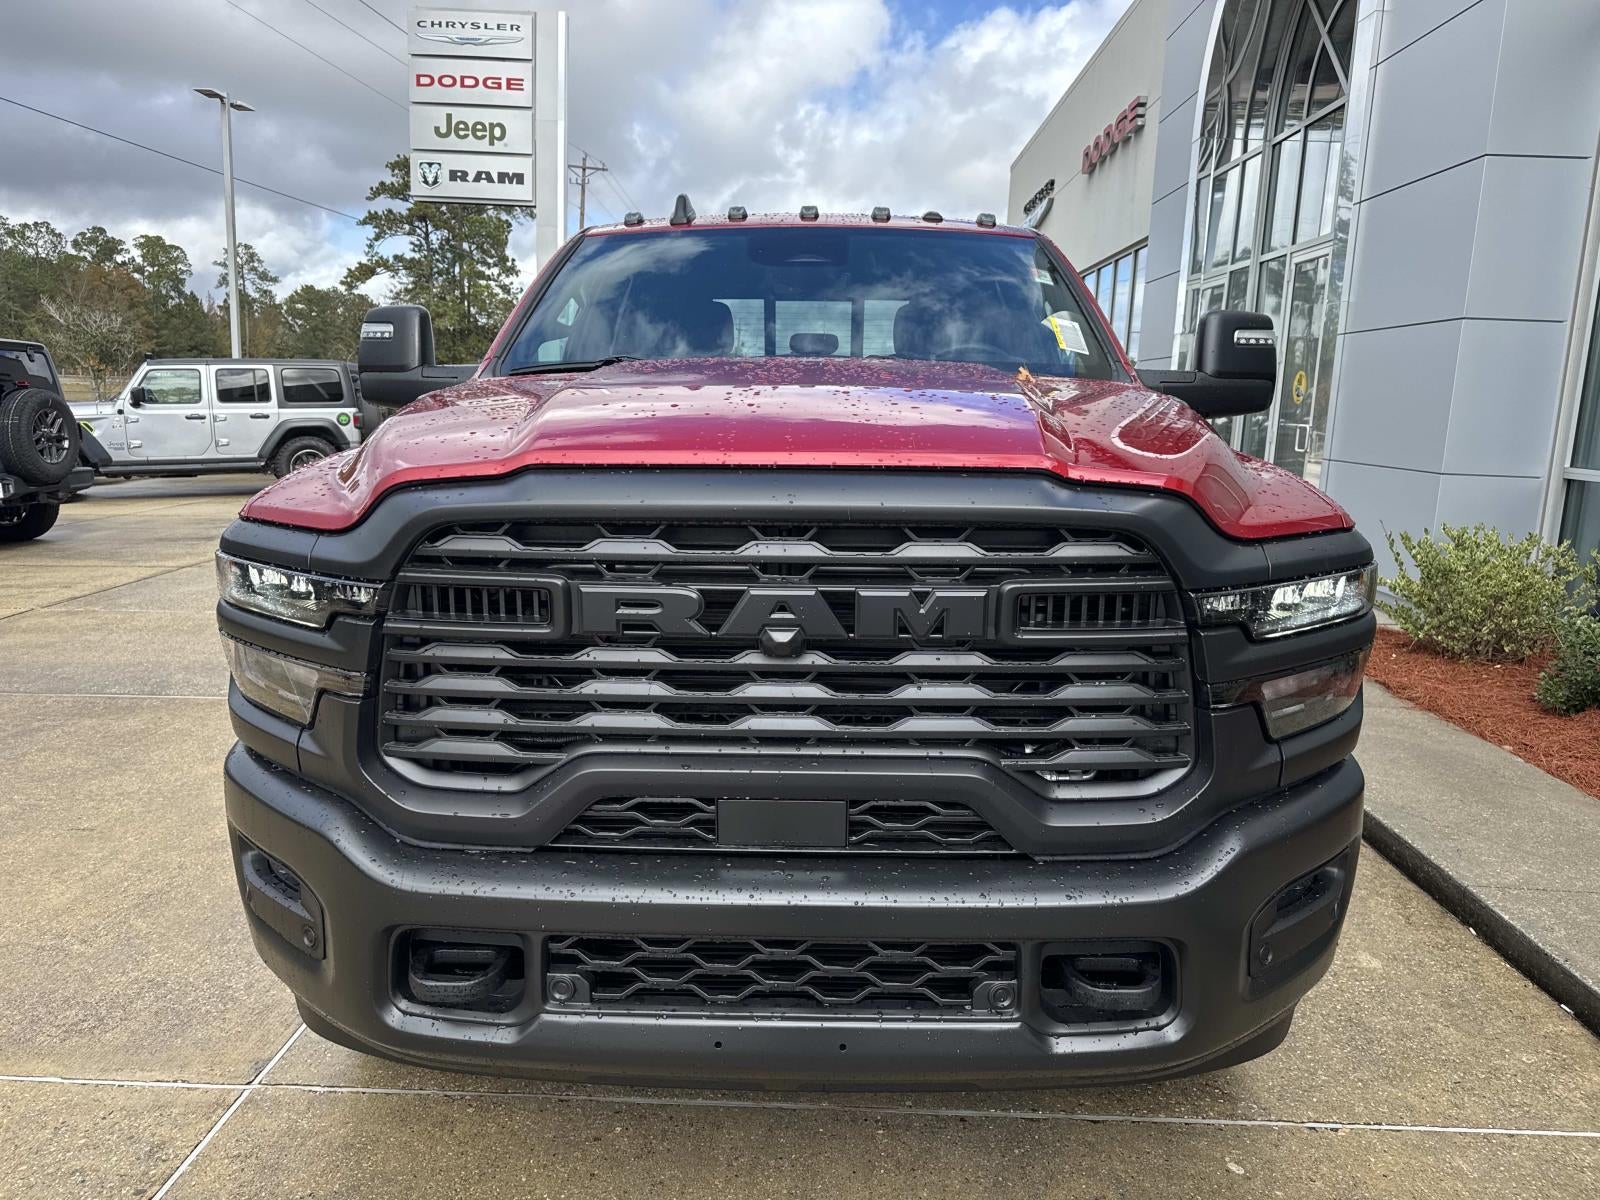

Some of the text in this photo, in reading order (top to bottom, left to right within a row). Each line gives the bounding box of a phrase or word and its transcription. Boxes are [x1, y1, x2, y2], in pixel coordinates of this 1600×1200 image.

[416, 20, 522, 32] CHRYSLER
[415, 73, 525, 91] DODGE
[433, 113, 507, 146] Jeep
[1081, 95, 1148, 175] DODGE
[448, 169, 525, 185] RAM
[577, 585, 989, 639] RAM
